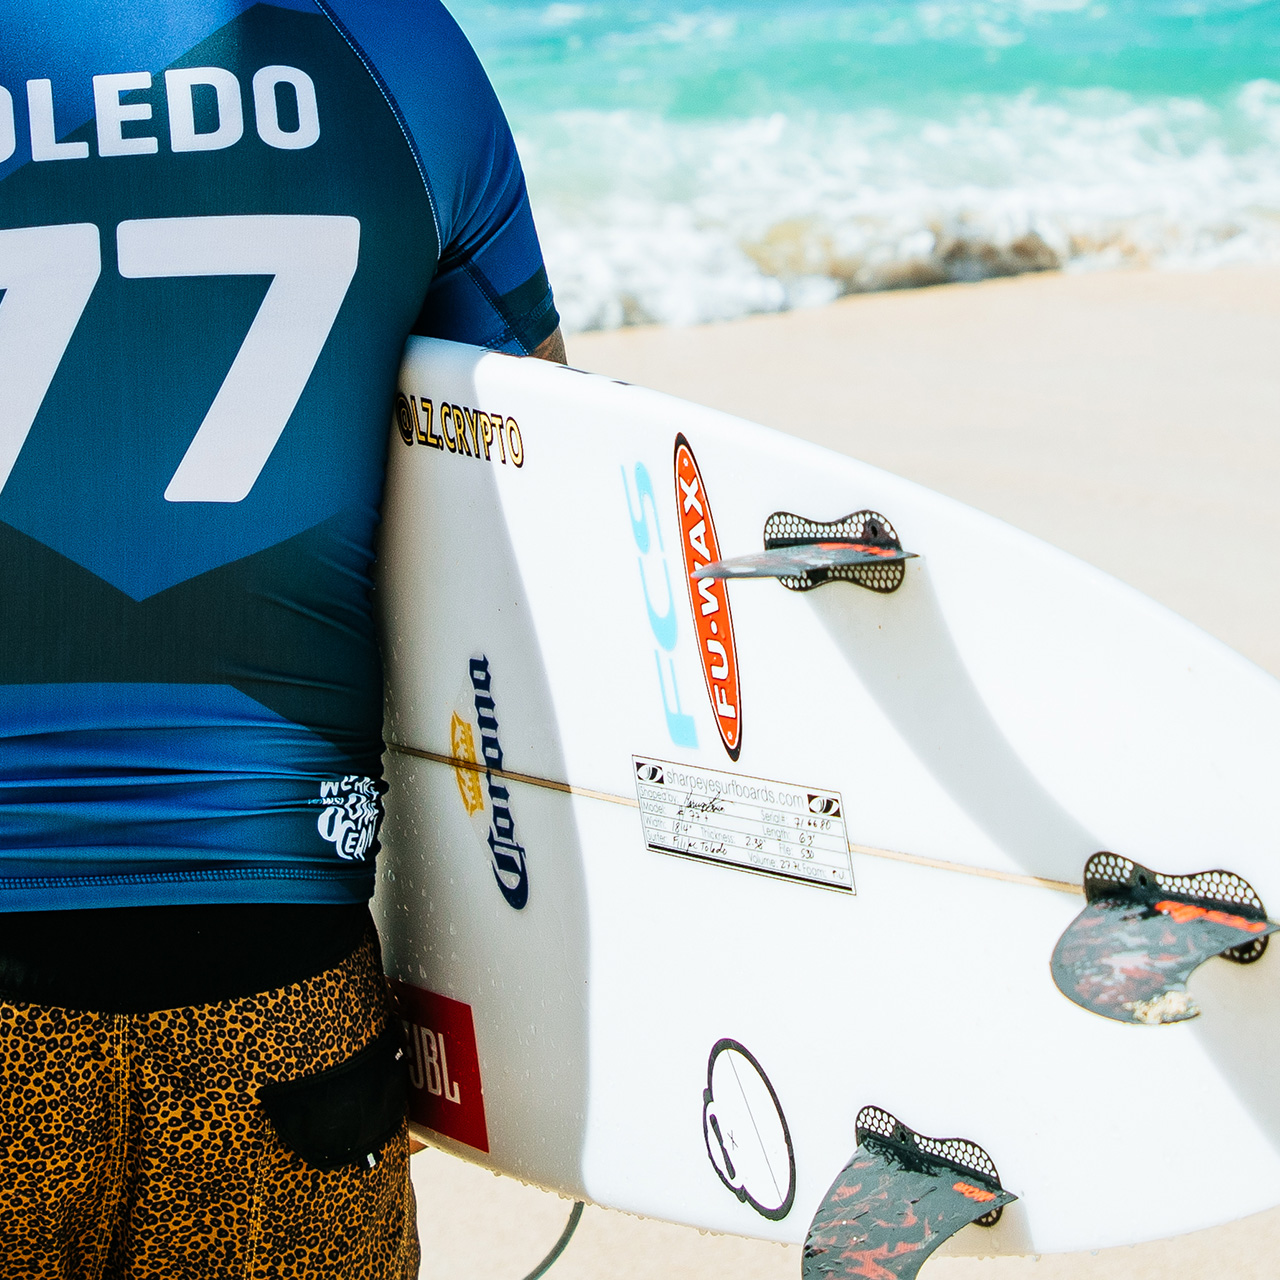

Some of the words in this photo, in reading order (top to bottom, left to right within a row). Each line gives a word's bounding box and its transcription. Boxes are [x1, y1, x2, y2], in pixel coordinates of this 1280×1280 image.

[396, 392, 525, 469] @LZ.CRYPTO
[468, 654, 530, 911] Corona
[666, 768, 805, 809] sharpeyesurfboards.com
[407, 1023, 462, 1105] JBL
